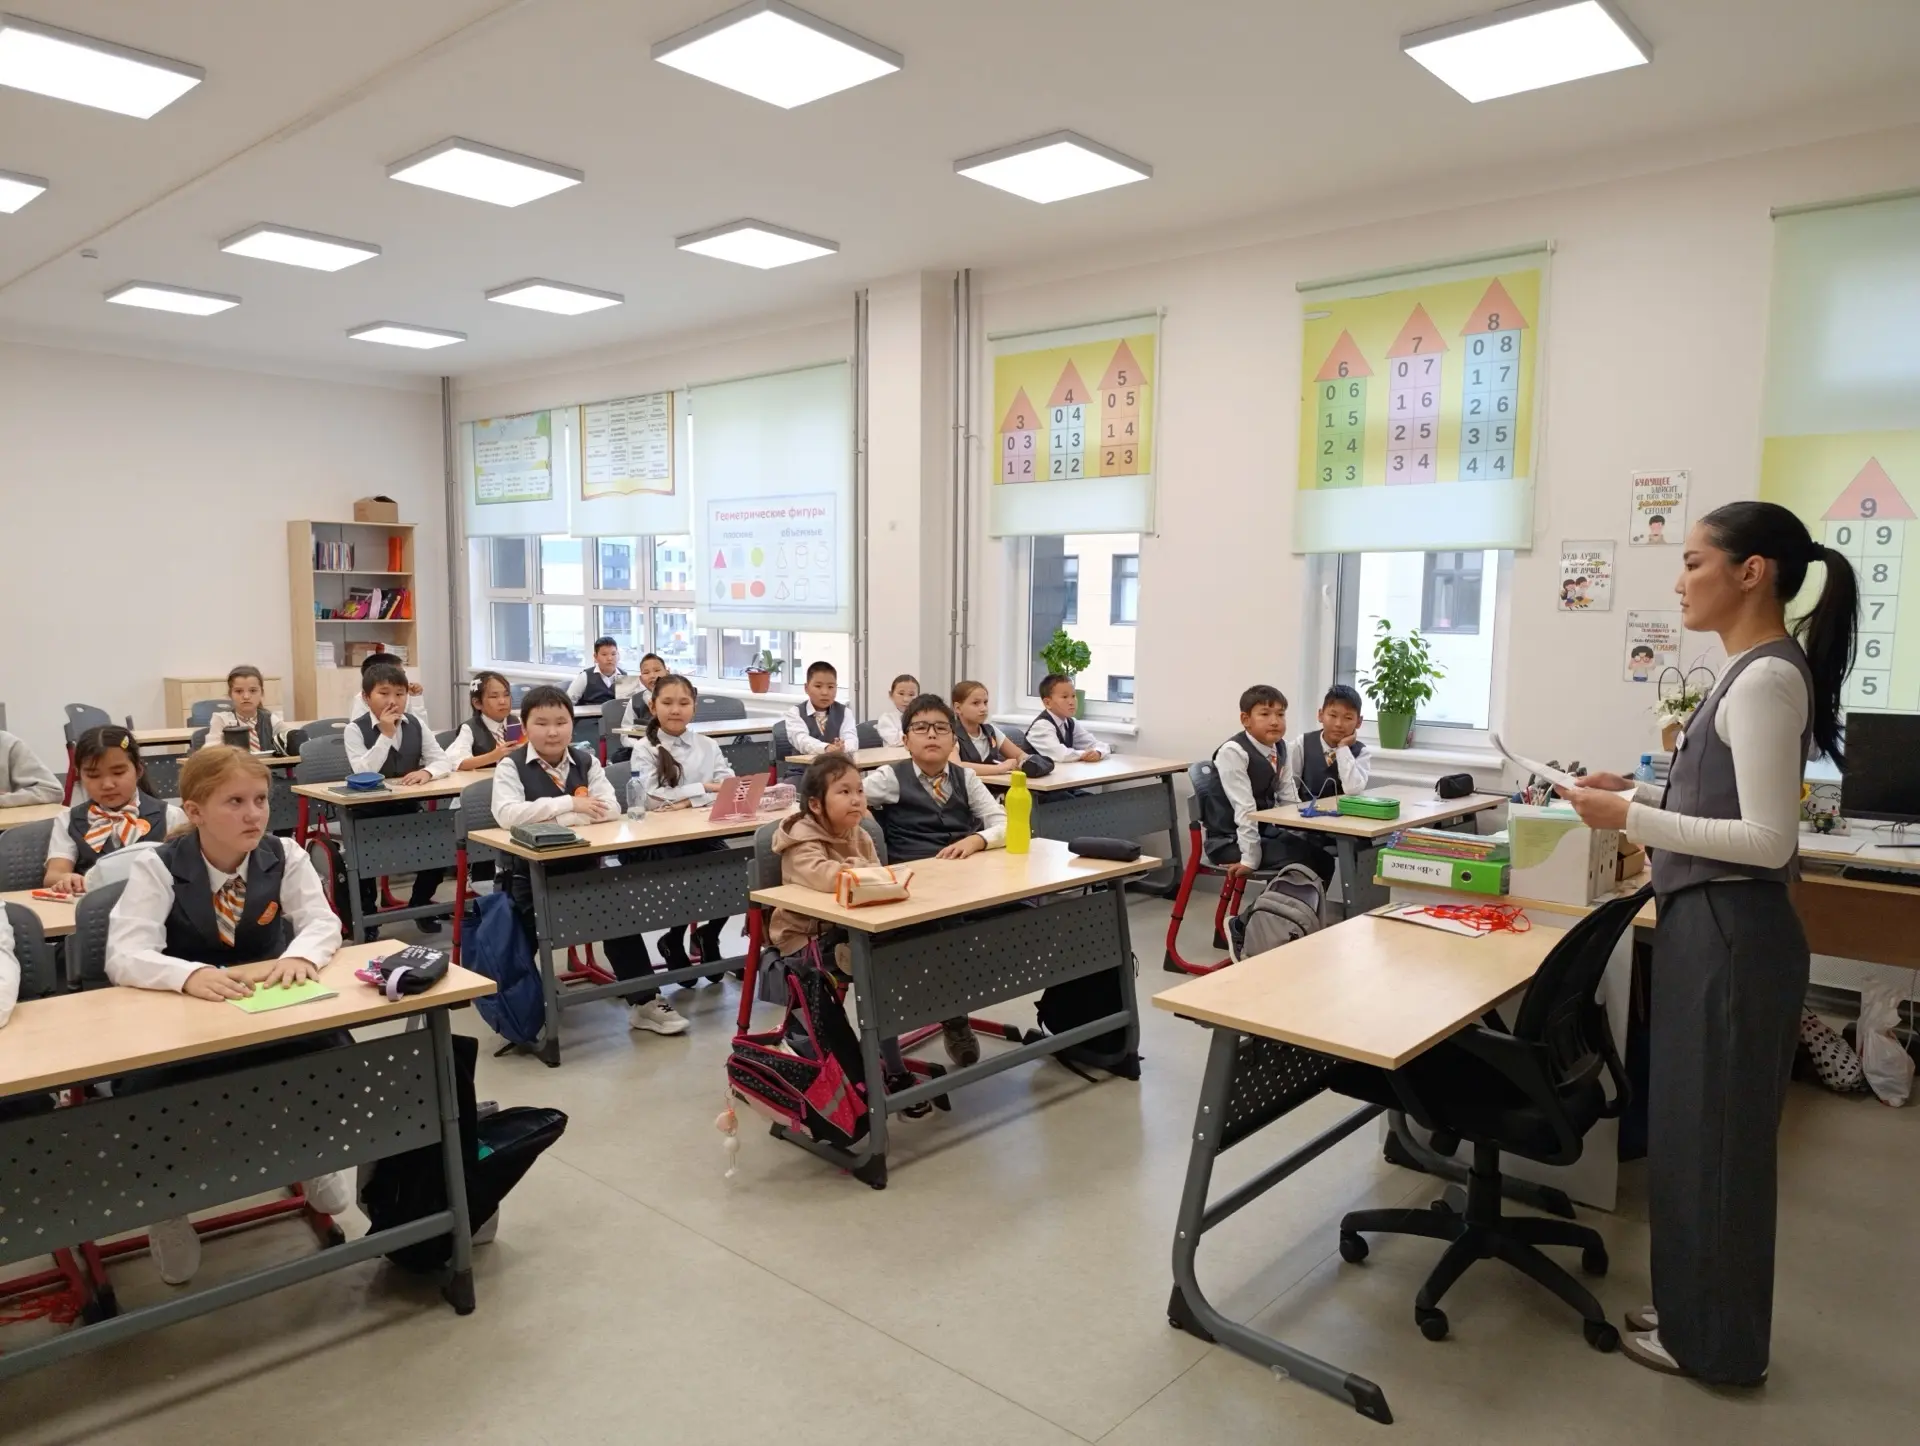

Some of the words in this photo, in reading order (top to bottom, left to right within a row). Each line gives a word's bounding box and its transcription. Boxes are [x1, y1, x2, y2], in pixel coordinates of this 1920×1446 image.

[1488, 313, 1499, 330] 8
[1412, 336, 1422, 353] 7
[1474, 340, 1484, 355] 0
[1501, 336, 1512, 352] 8
[1338, 362, 1349, 377] 6
[1398, 362, 1408, 377] 0
[1424, 359, 1434, 374] 7
[1473, 369, 1482, 385] 1
[1500, 366, 1510, 382] 7
[1118, 371, 1127, 386] 5
[1065, 389, 1073, 403] 4
[1326, 385, 1335, 400] 0
[1350, 383, 1359, 397] 6
[1108, 394, 1116, 408] 0
[1127, 392, 1134, 405] 5
[1397, 395, 1406, 410] 1
[1422, 392, 1432, 407] 6
[1470, 399, 1481, 415] 2
[1497, 396, 1508, 412] 6
[1016, 415, 1024, 429] 3
[1055, 409, 1063, 423] 0
[1072, 407, 1080, 420] 4
[1326, 413, 1334, 428] 1
[1349, 411, 1358, 426] 5
[1108, 424, 1115, 438] 1
[1125, 422, 1133, 435] 4
[1395, 425, 1405, 440] 2
[1420, 423, 1430, 438] 5
[1469, 428, 1479, 444] 3
[1496, 426, 1507, 442] 5
[1008, 437, 1015, 450] 0
[1024, 435, 1031, 449] 3
[1055, 435, 1062, 448] 1
[1072, 433, 1080, 447] 3
[1324, 440, 1333, 455] 2
[1347, 439, 1357, 452] 4
[1054, 460, 1062, 473] 2
[1071, 458, 1079, 472] 2
[1107, 452, 1114, 465] 2
[1125, 450, 1132, 464] 3
[1393, 455, 1403, 470] 3
[1418, 454, 1429, 468] 4
[1467, 458, 1478, 473] 4
[1494, 456, 1505, 471] 4
[1008, 462, 1014, 474] 1
[1024, 460, 1031, 473] 2
[1323, 467, 1332, 482] 3
[1346, 466, 1355, 480] 3
[715, 509, 786, 521] Геометрические
[788, 507, 826, 519] фигуры
[1861, 498, 1877, 518] 9
[1837, 527, 1851, 545] 0
[1876, 526, 1892, 545] 9
[1873, 564, 1888, 582] 8
[1870, 603, 1884, 620] 7
[1865, 640, 1880, 658] 6
[1862, 677, 1877, 695] 5
[1391, 862, 1415, 870] класс
[1435, 868, 1441, 876] 3
